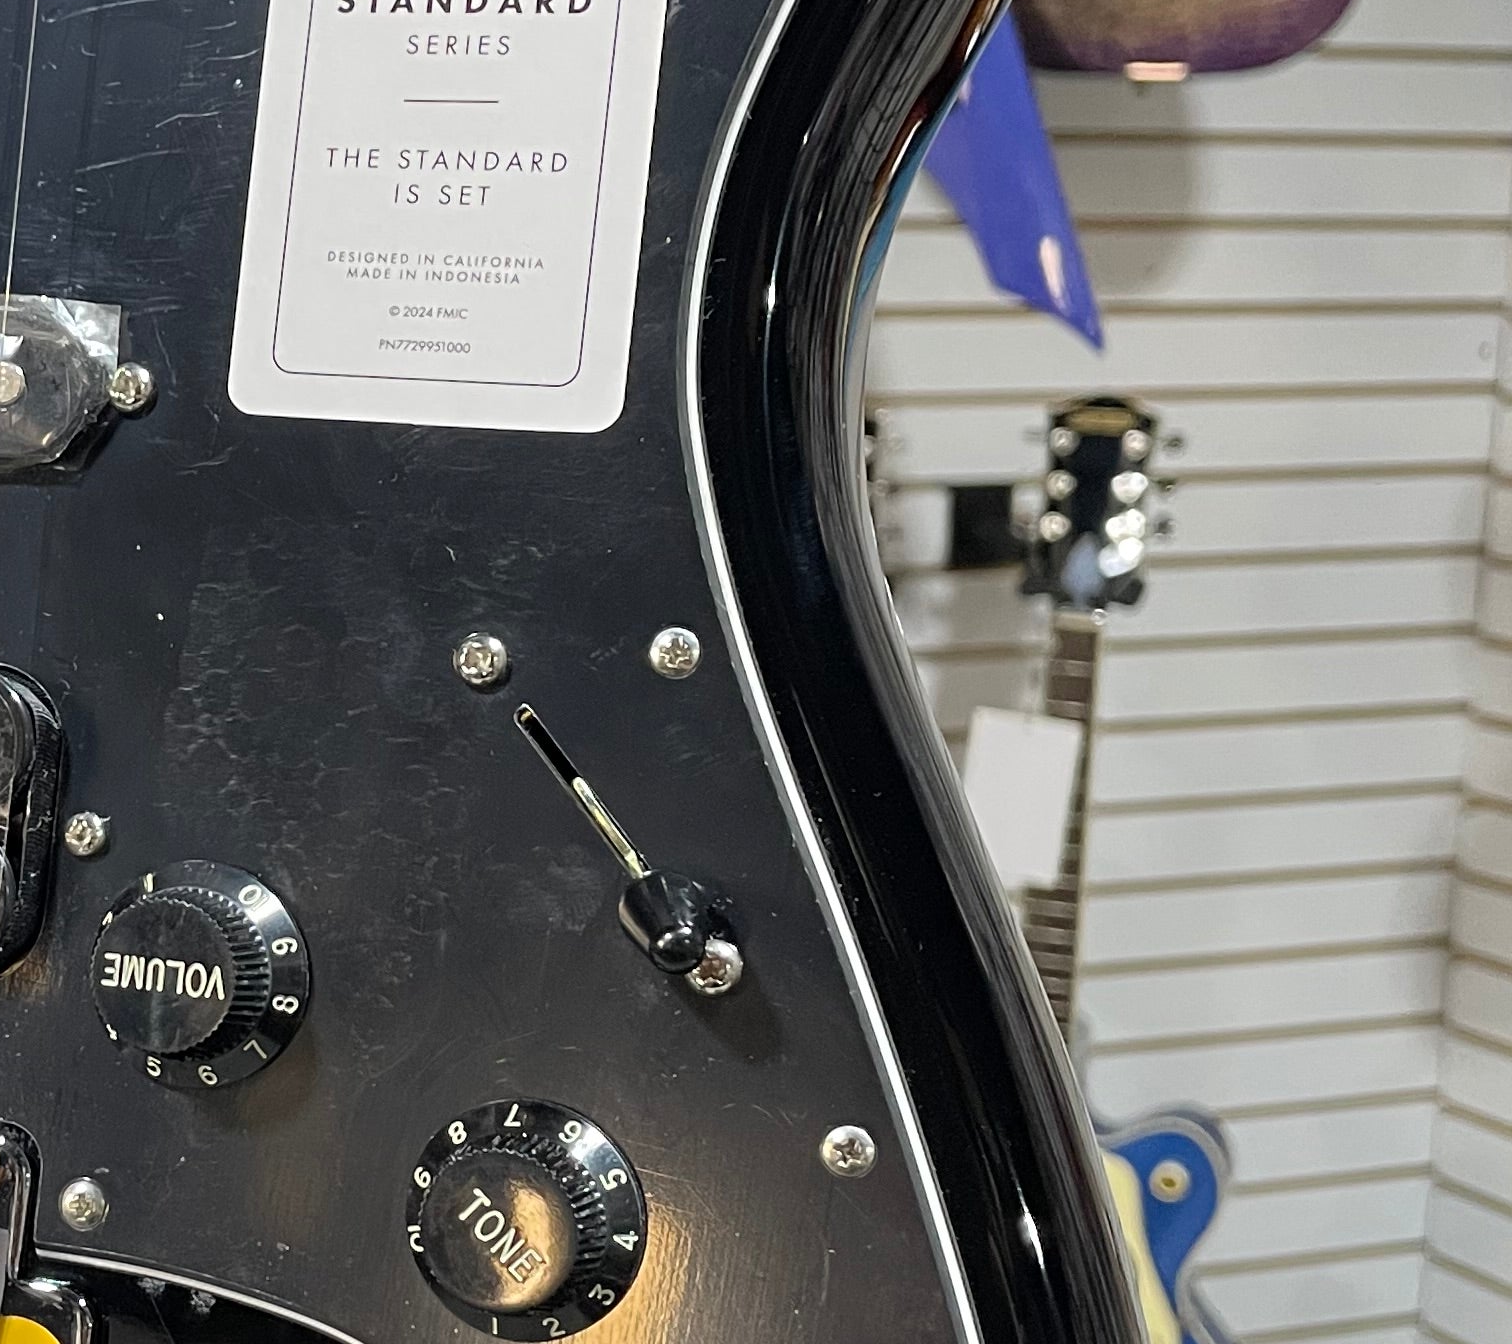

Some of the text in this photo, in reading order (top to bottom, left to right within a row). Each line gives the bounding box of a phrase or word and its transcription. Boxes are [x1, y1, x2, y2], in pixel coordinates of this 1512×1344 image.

[406, 34, 512, 56] SERIES
[326, 147, 569, 173] THE STANDARD
[393, 183, 491, 207] IS SET
[327, 251, 545, 269] DESIGNED IN CALIFORNIA
[345, 268, 521, 285] MADE IN INDONESIA
[403, 306, 433, 319] 2024
[437, 307, 469, 320] FMIC
[100, 952, 226, 1001] VOLUME
[272, 994, 299, 1015] 8
[243, 1039, 267, 1060] 7
[145, 1056, 162, 1077] 5
[197, 1064, 219, 1086] 6
[503, 1103, 522, 1128] 7
[447, 1120, 468, 1146] 8
[599, 1168, 629, 1192] 5
[458, 1187, 547, 1284] TONE
[612, 1230, 639, 1252] 4
[588, 1283, 616, 1306] 3
[541, 1316, 567, 1338] 2
